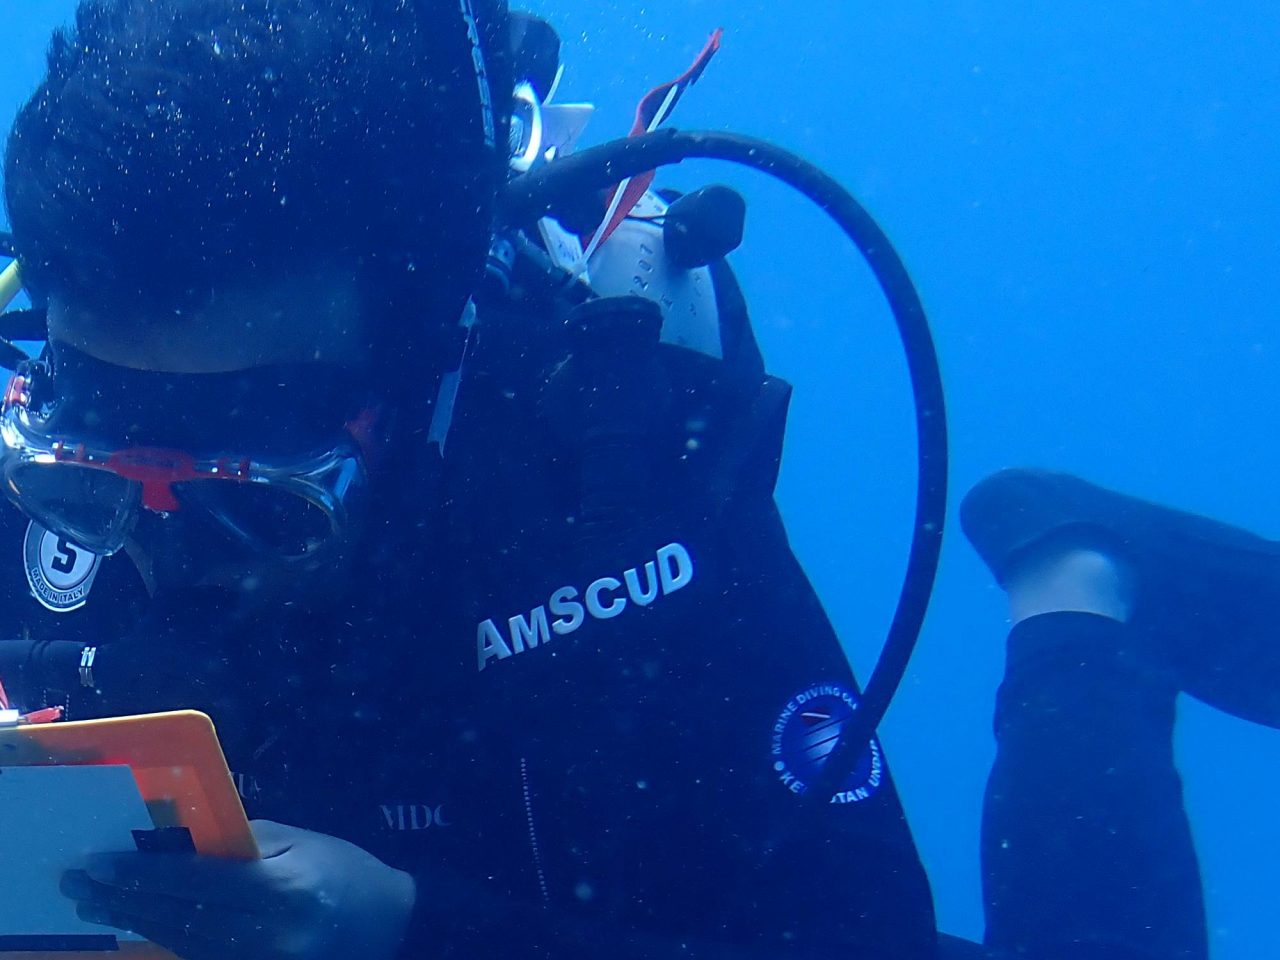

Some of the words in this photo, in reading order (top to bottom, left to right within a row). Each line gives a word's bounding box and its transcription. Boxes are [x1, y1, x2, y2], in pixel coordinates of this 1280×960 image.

[31, 568, 48, 597] MADE
[48, 591, 58, 603] IN
[58, 586, 84, 603] ITALY
[476, 542, 694, 673] AMSCUD
[771, 701, 798, 755] MARINE
[795, 686, 840, 704] DIVING
[378, 804, 453, 830] MDC
